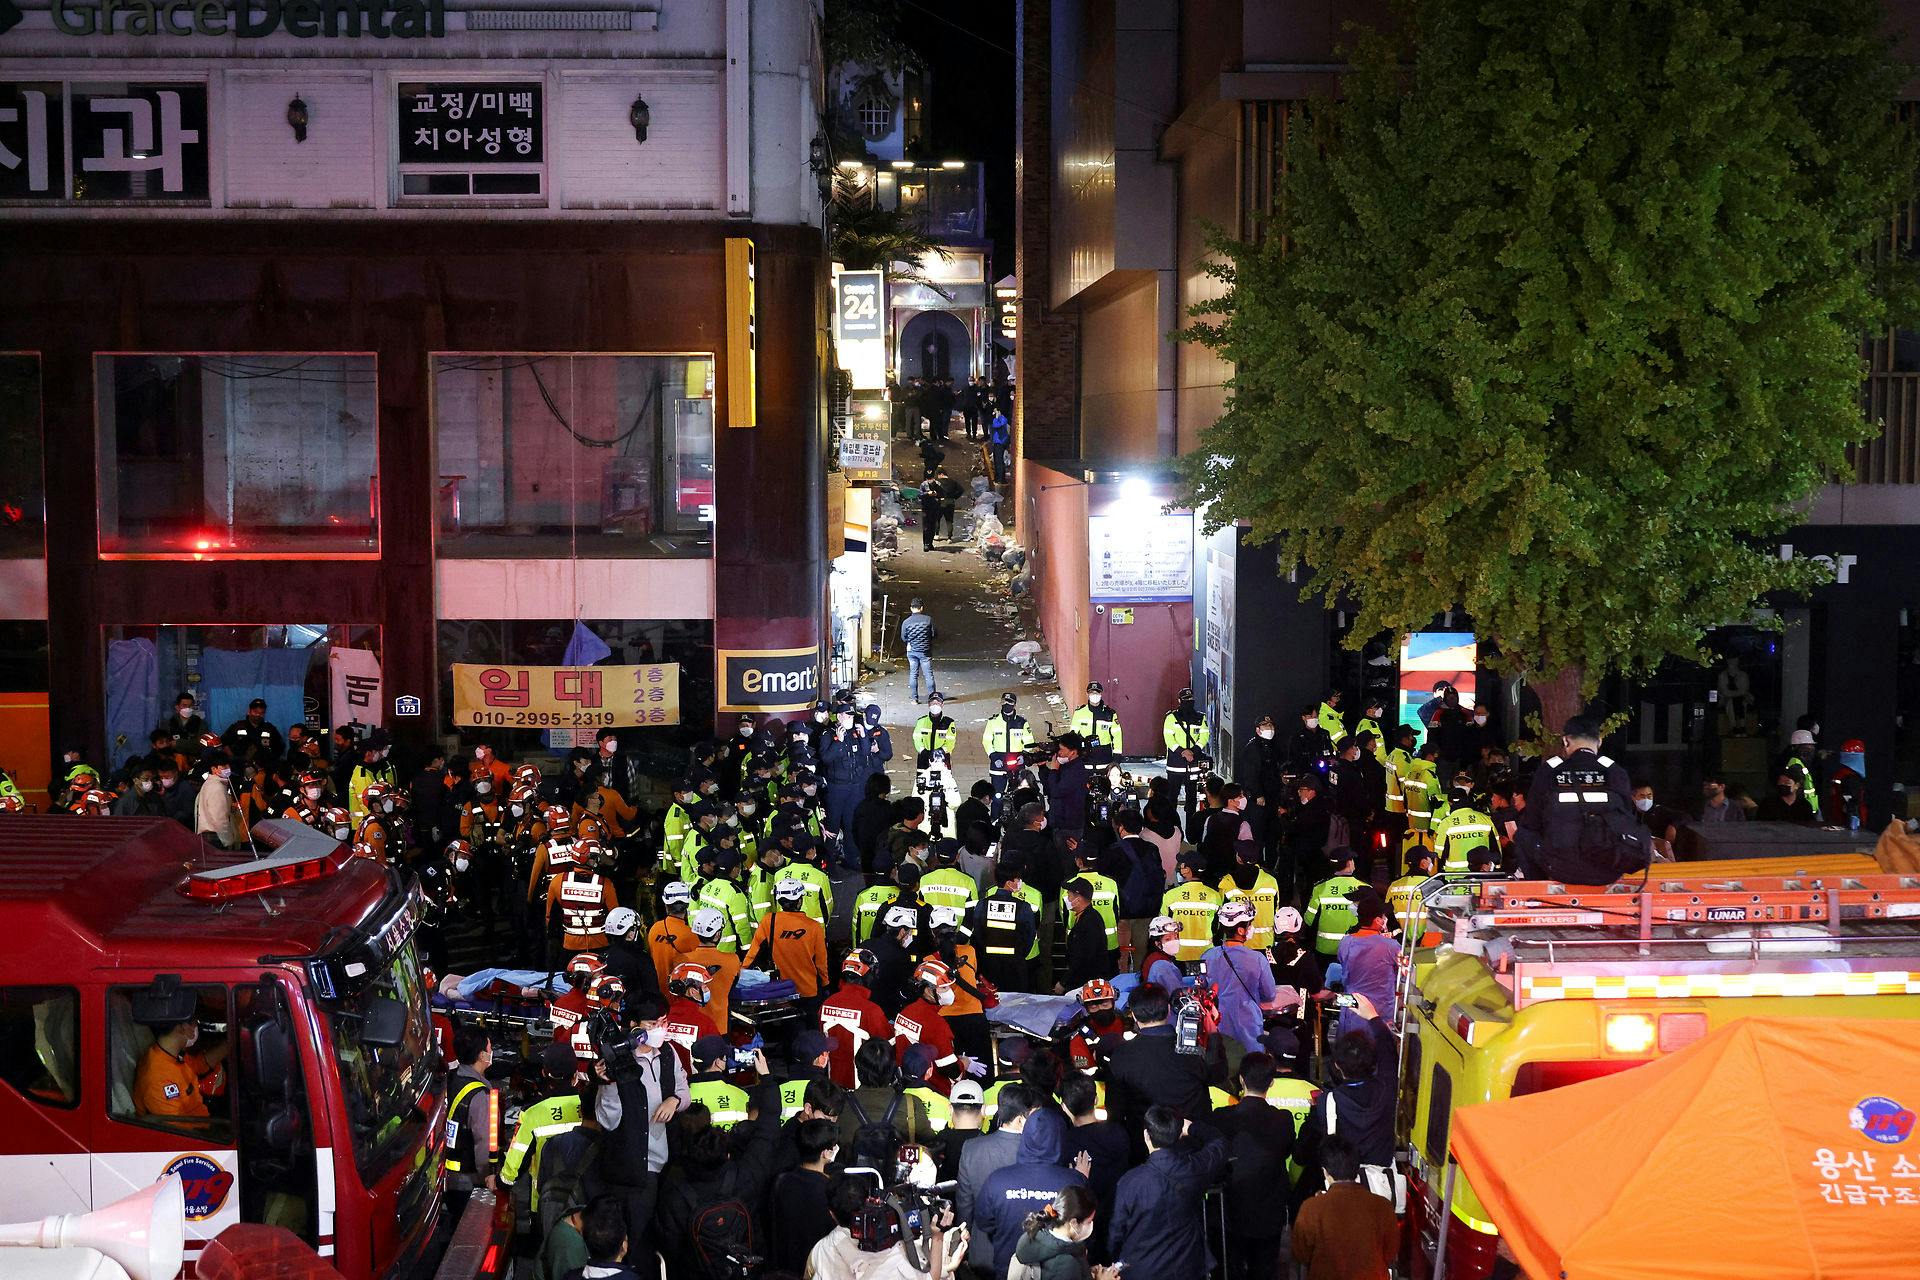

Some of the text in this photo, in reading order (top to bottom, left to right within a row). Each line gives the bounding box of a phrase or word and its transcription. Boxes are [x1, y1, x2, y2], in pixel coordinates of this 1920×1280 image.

[412, 92, 533, 119] 교정/미백
[414, 127, 533, 155] 치아성형
[844, 294, 877, 320] 24
[633, 667, 664, 684] 1층
[633, 686, 665, 704] 2층
[400, 705, 416, 713] 173
[634, 707, 666, 724] 3층
[472, 711, 615, 726] 010-2995-2319
[1450, 832, 1484, 840] POLICE
[1235, 895, 1272, 903] POLICE
[1176, 909, 1211, 917] POLICE
[1707, 910, 1745, 921] LUNAR
[1866, 1110, 1917, 1136] 119
[1811, 1147, 1877, 1182] 용산
[1818, 1183, 1920, 1206] 긴급구조
